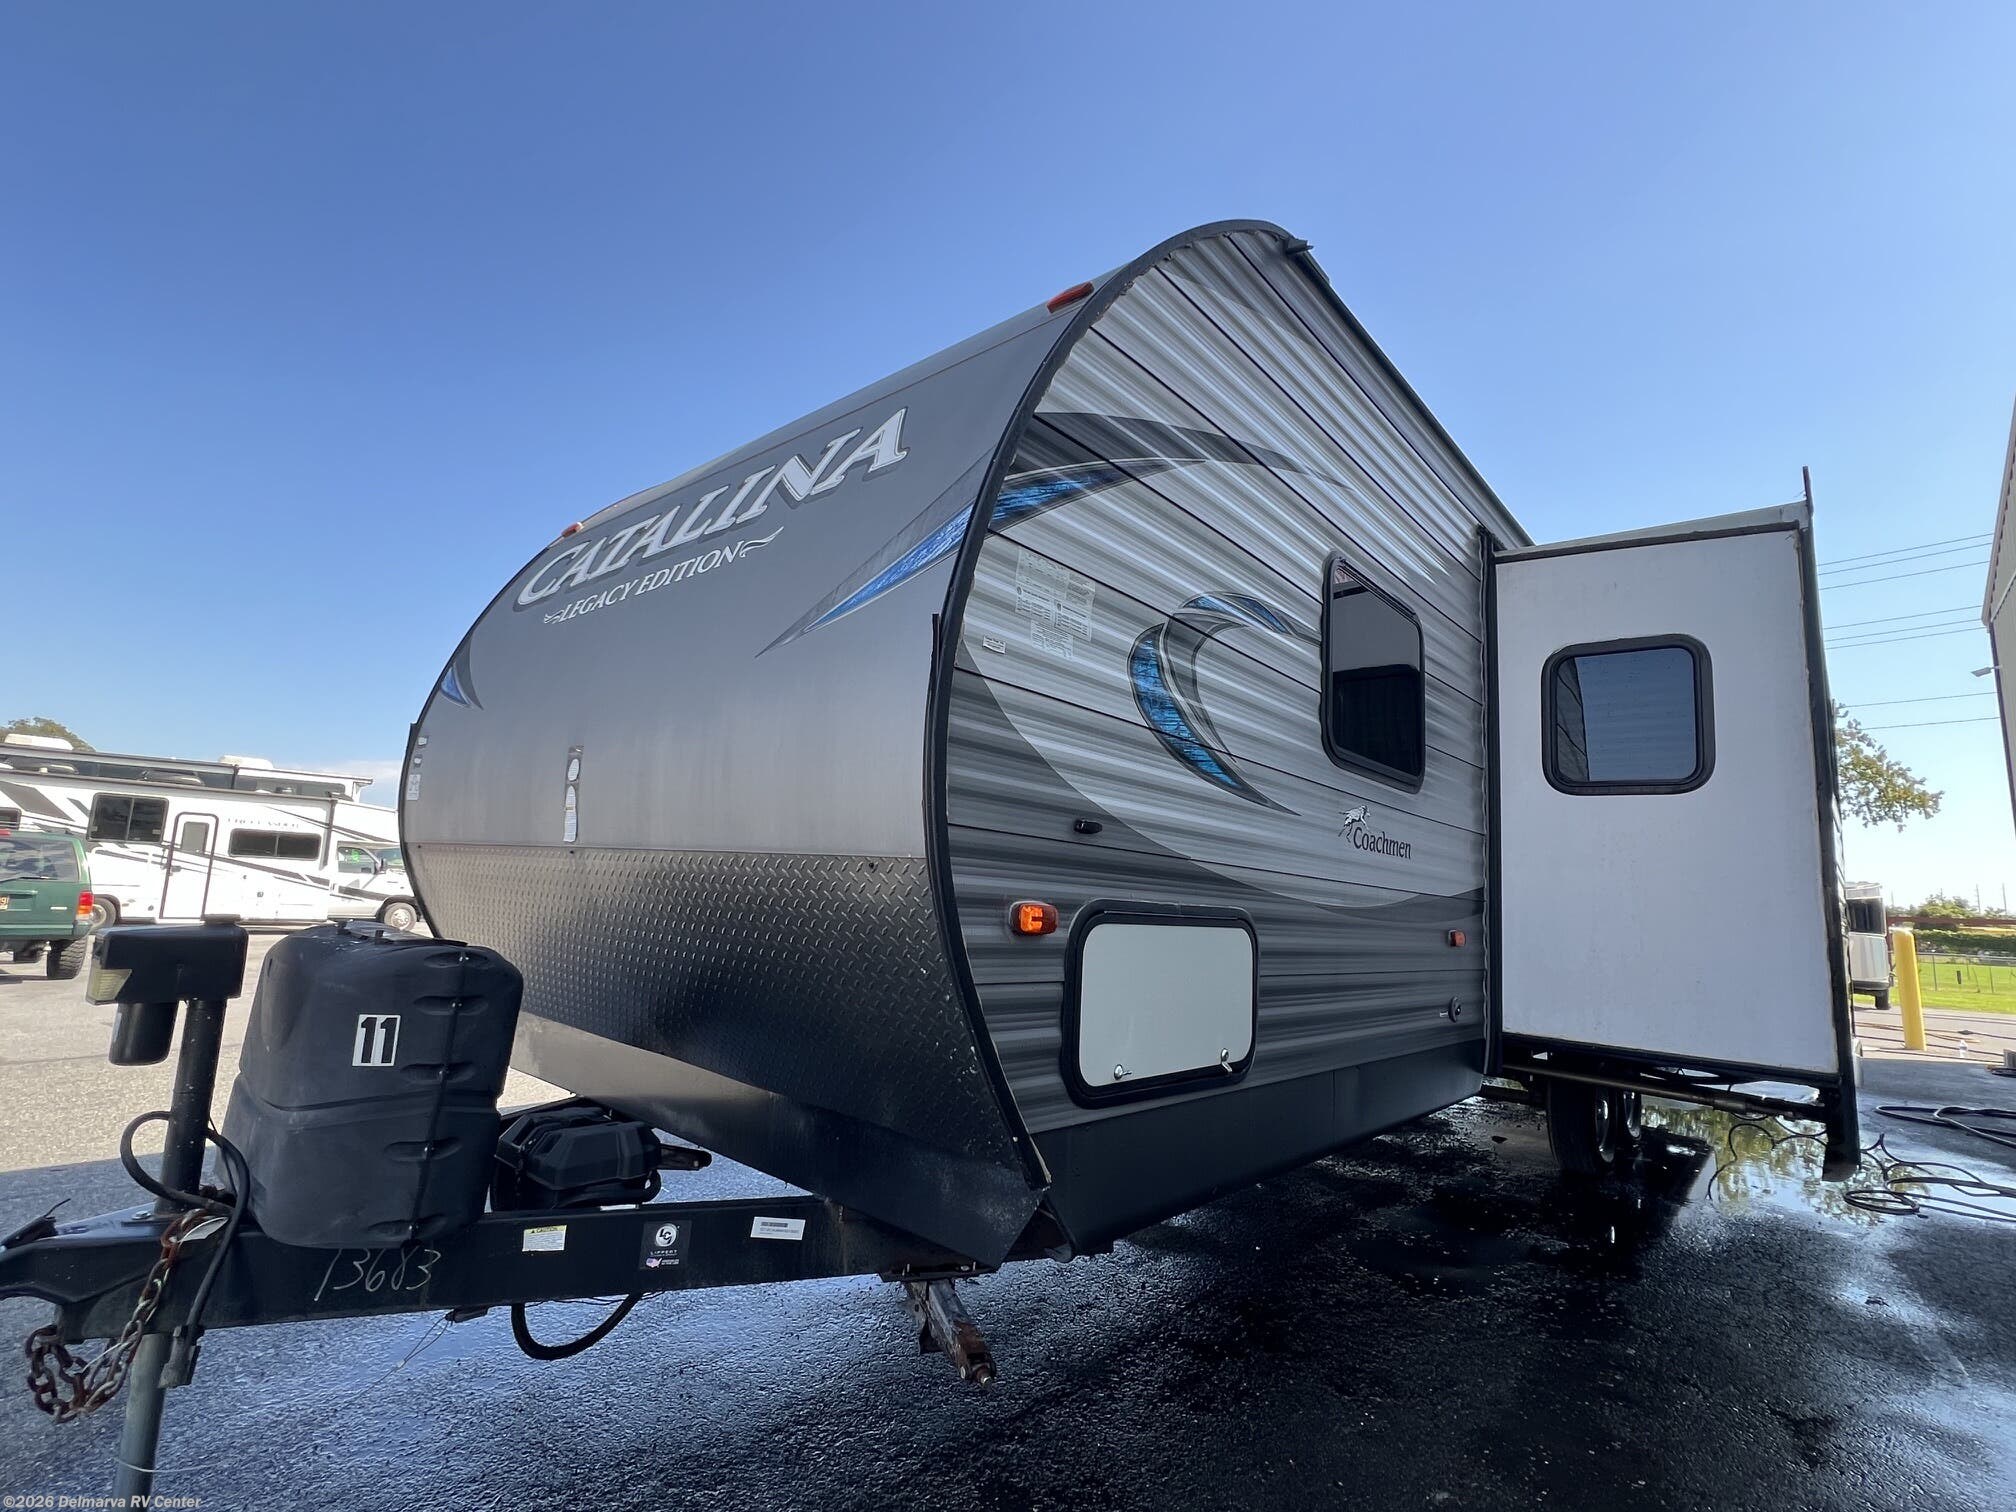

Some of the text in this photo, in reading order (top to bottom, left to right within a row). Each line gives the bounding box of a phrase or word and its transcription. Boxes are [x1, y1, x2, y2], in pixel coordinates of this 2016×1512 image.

[515, 407, 909, 607] CATALINA
[559, 540, 744, 623] LEGACY EDITION
[1353, 827, 1411, 858] Coachmen
[360, 1017, 398, 1063] 11
